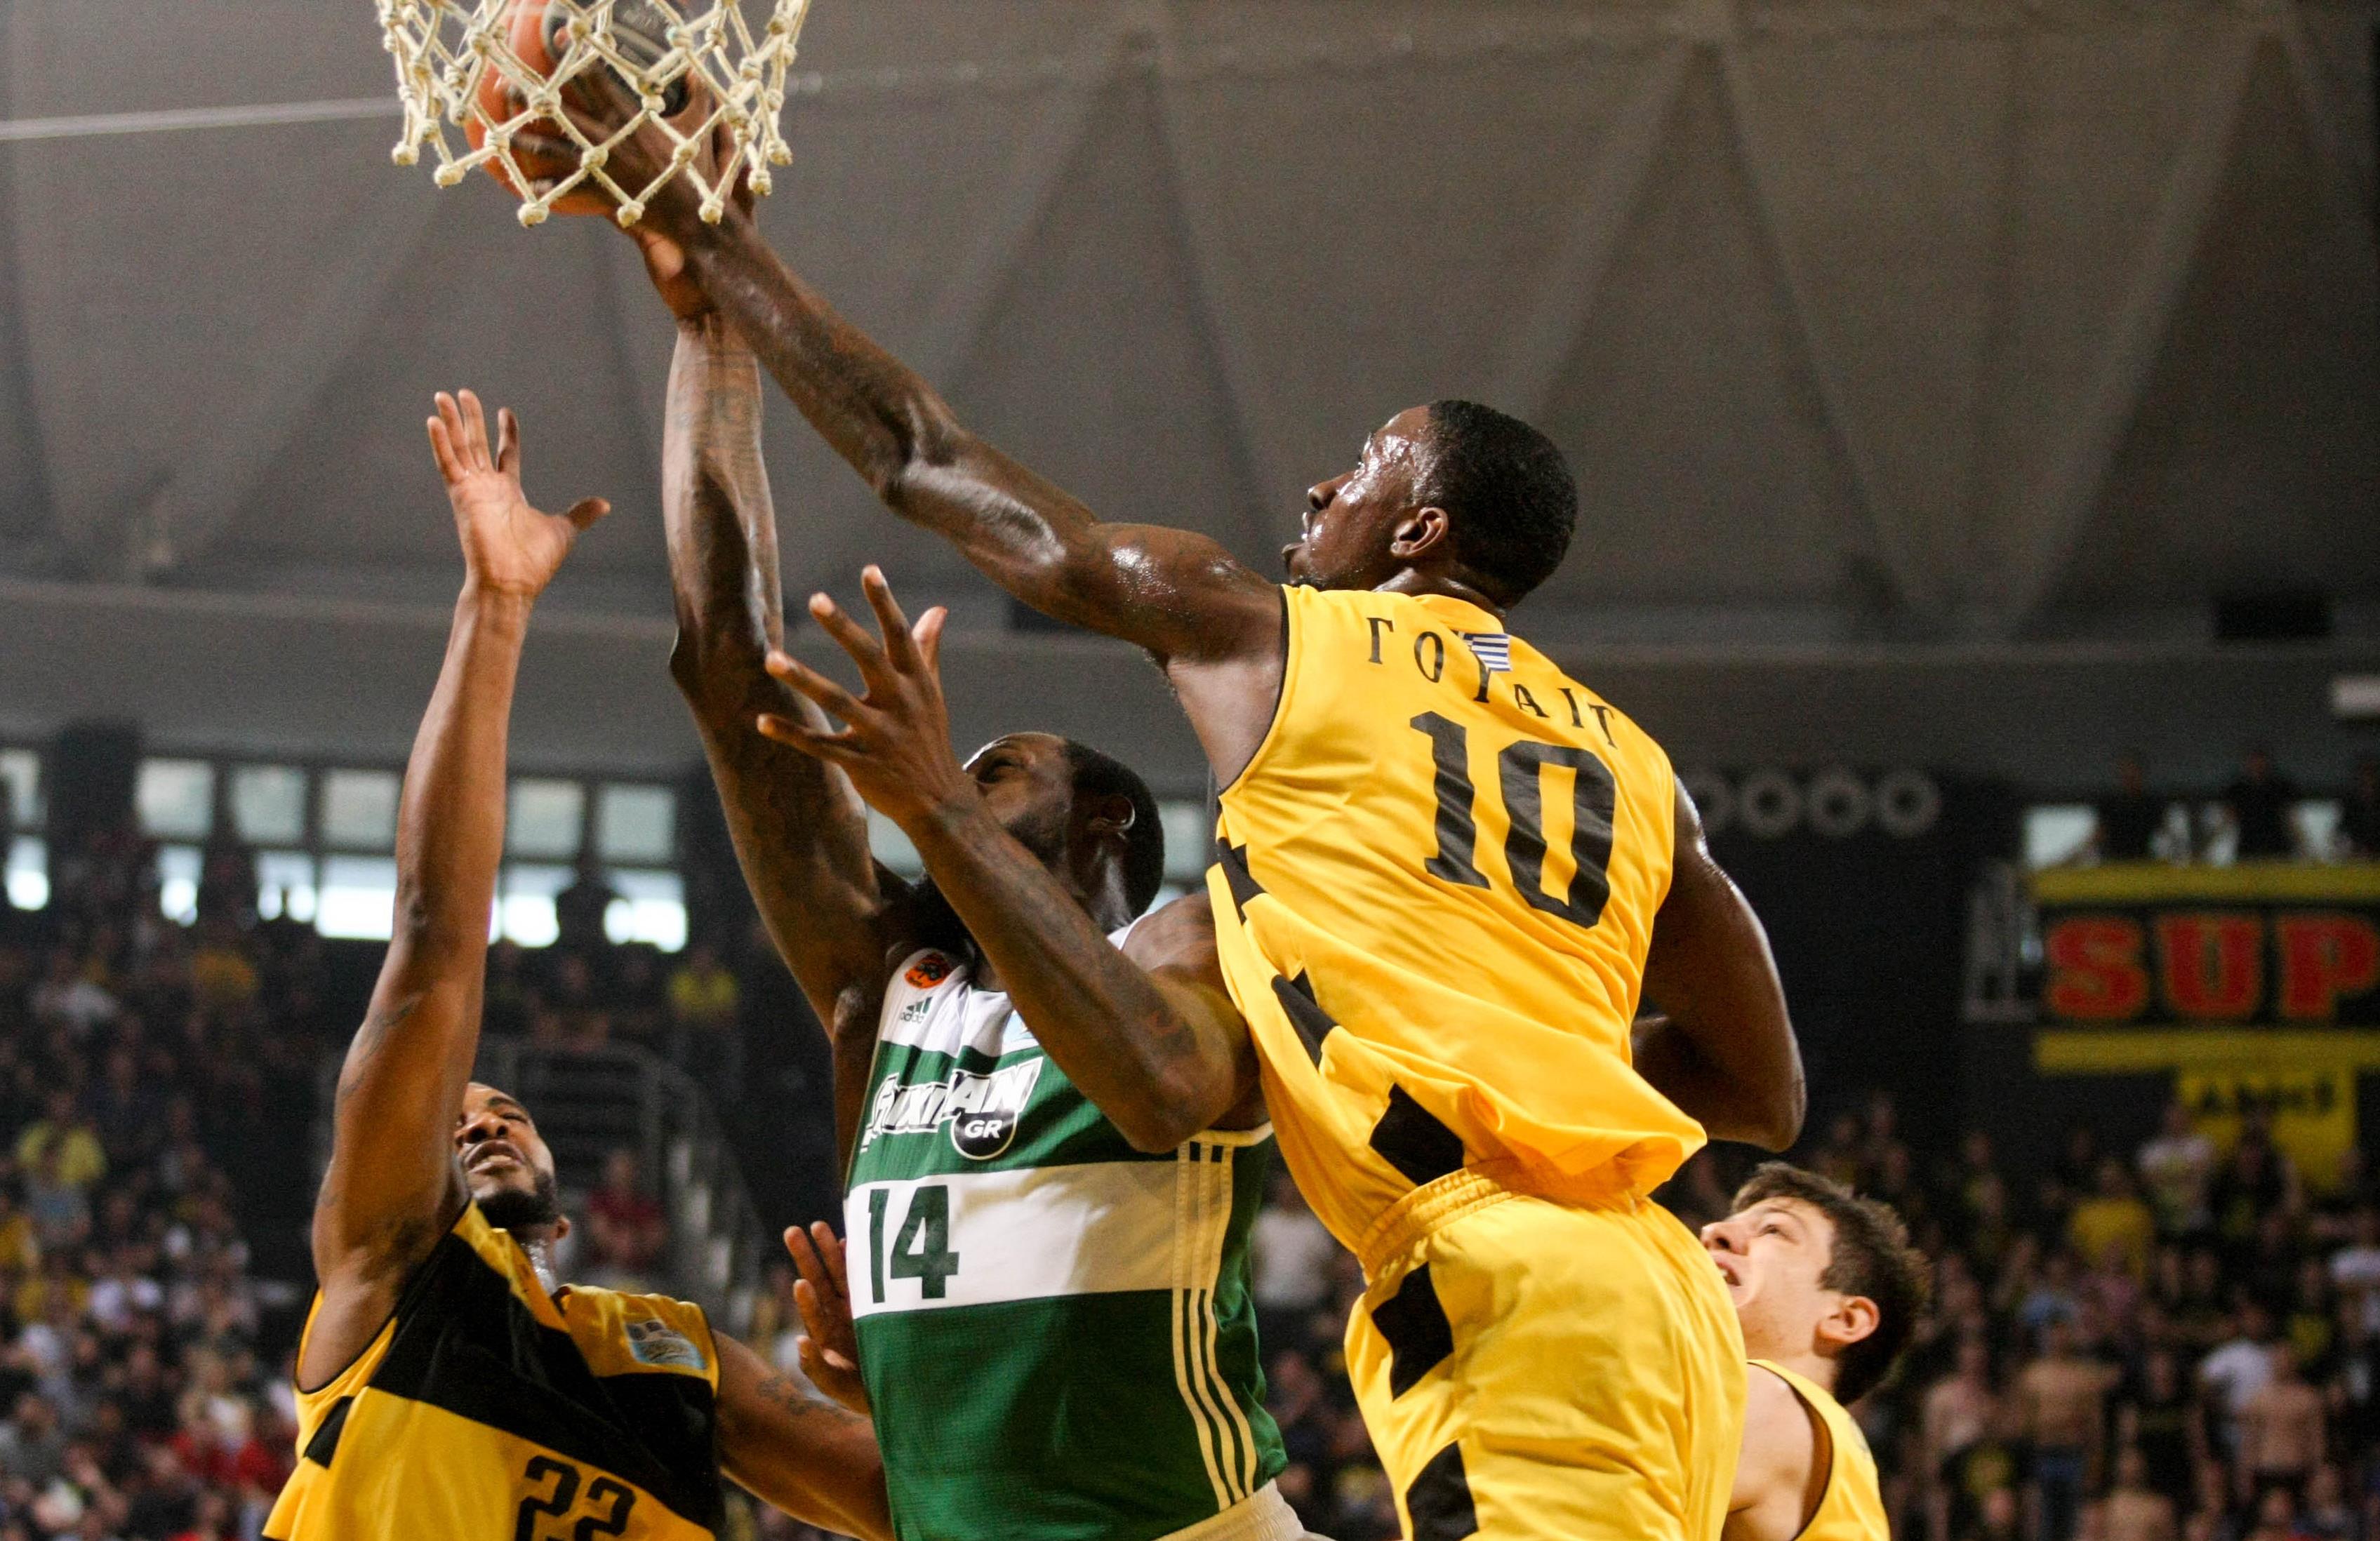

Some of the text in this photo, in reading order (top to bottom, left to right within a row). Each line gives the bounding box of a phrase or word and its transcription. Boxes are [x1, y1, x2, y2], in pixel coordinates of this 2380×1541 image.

[1409, 711, 1616, 929] 10
[964, 1119, 1003, 1138] GR
[867, 1184, 960, 1304] 14
[514, 1455, 637, 1541] 22
